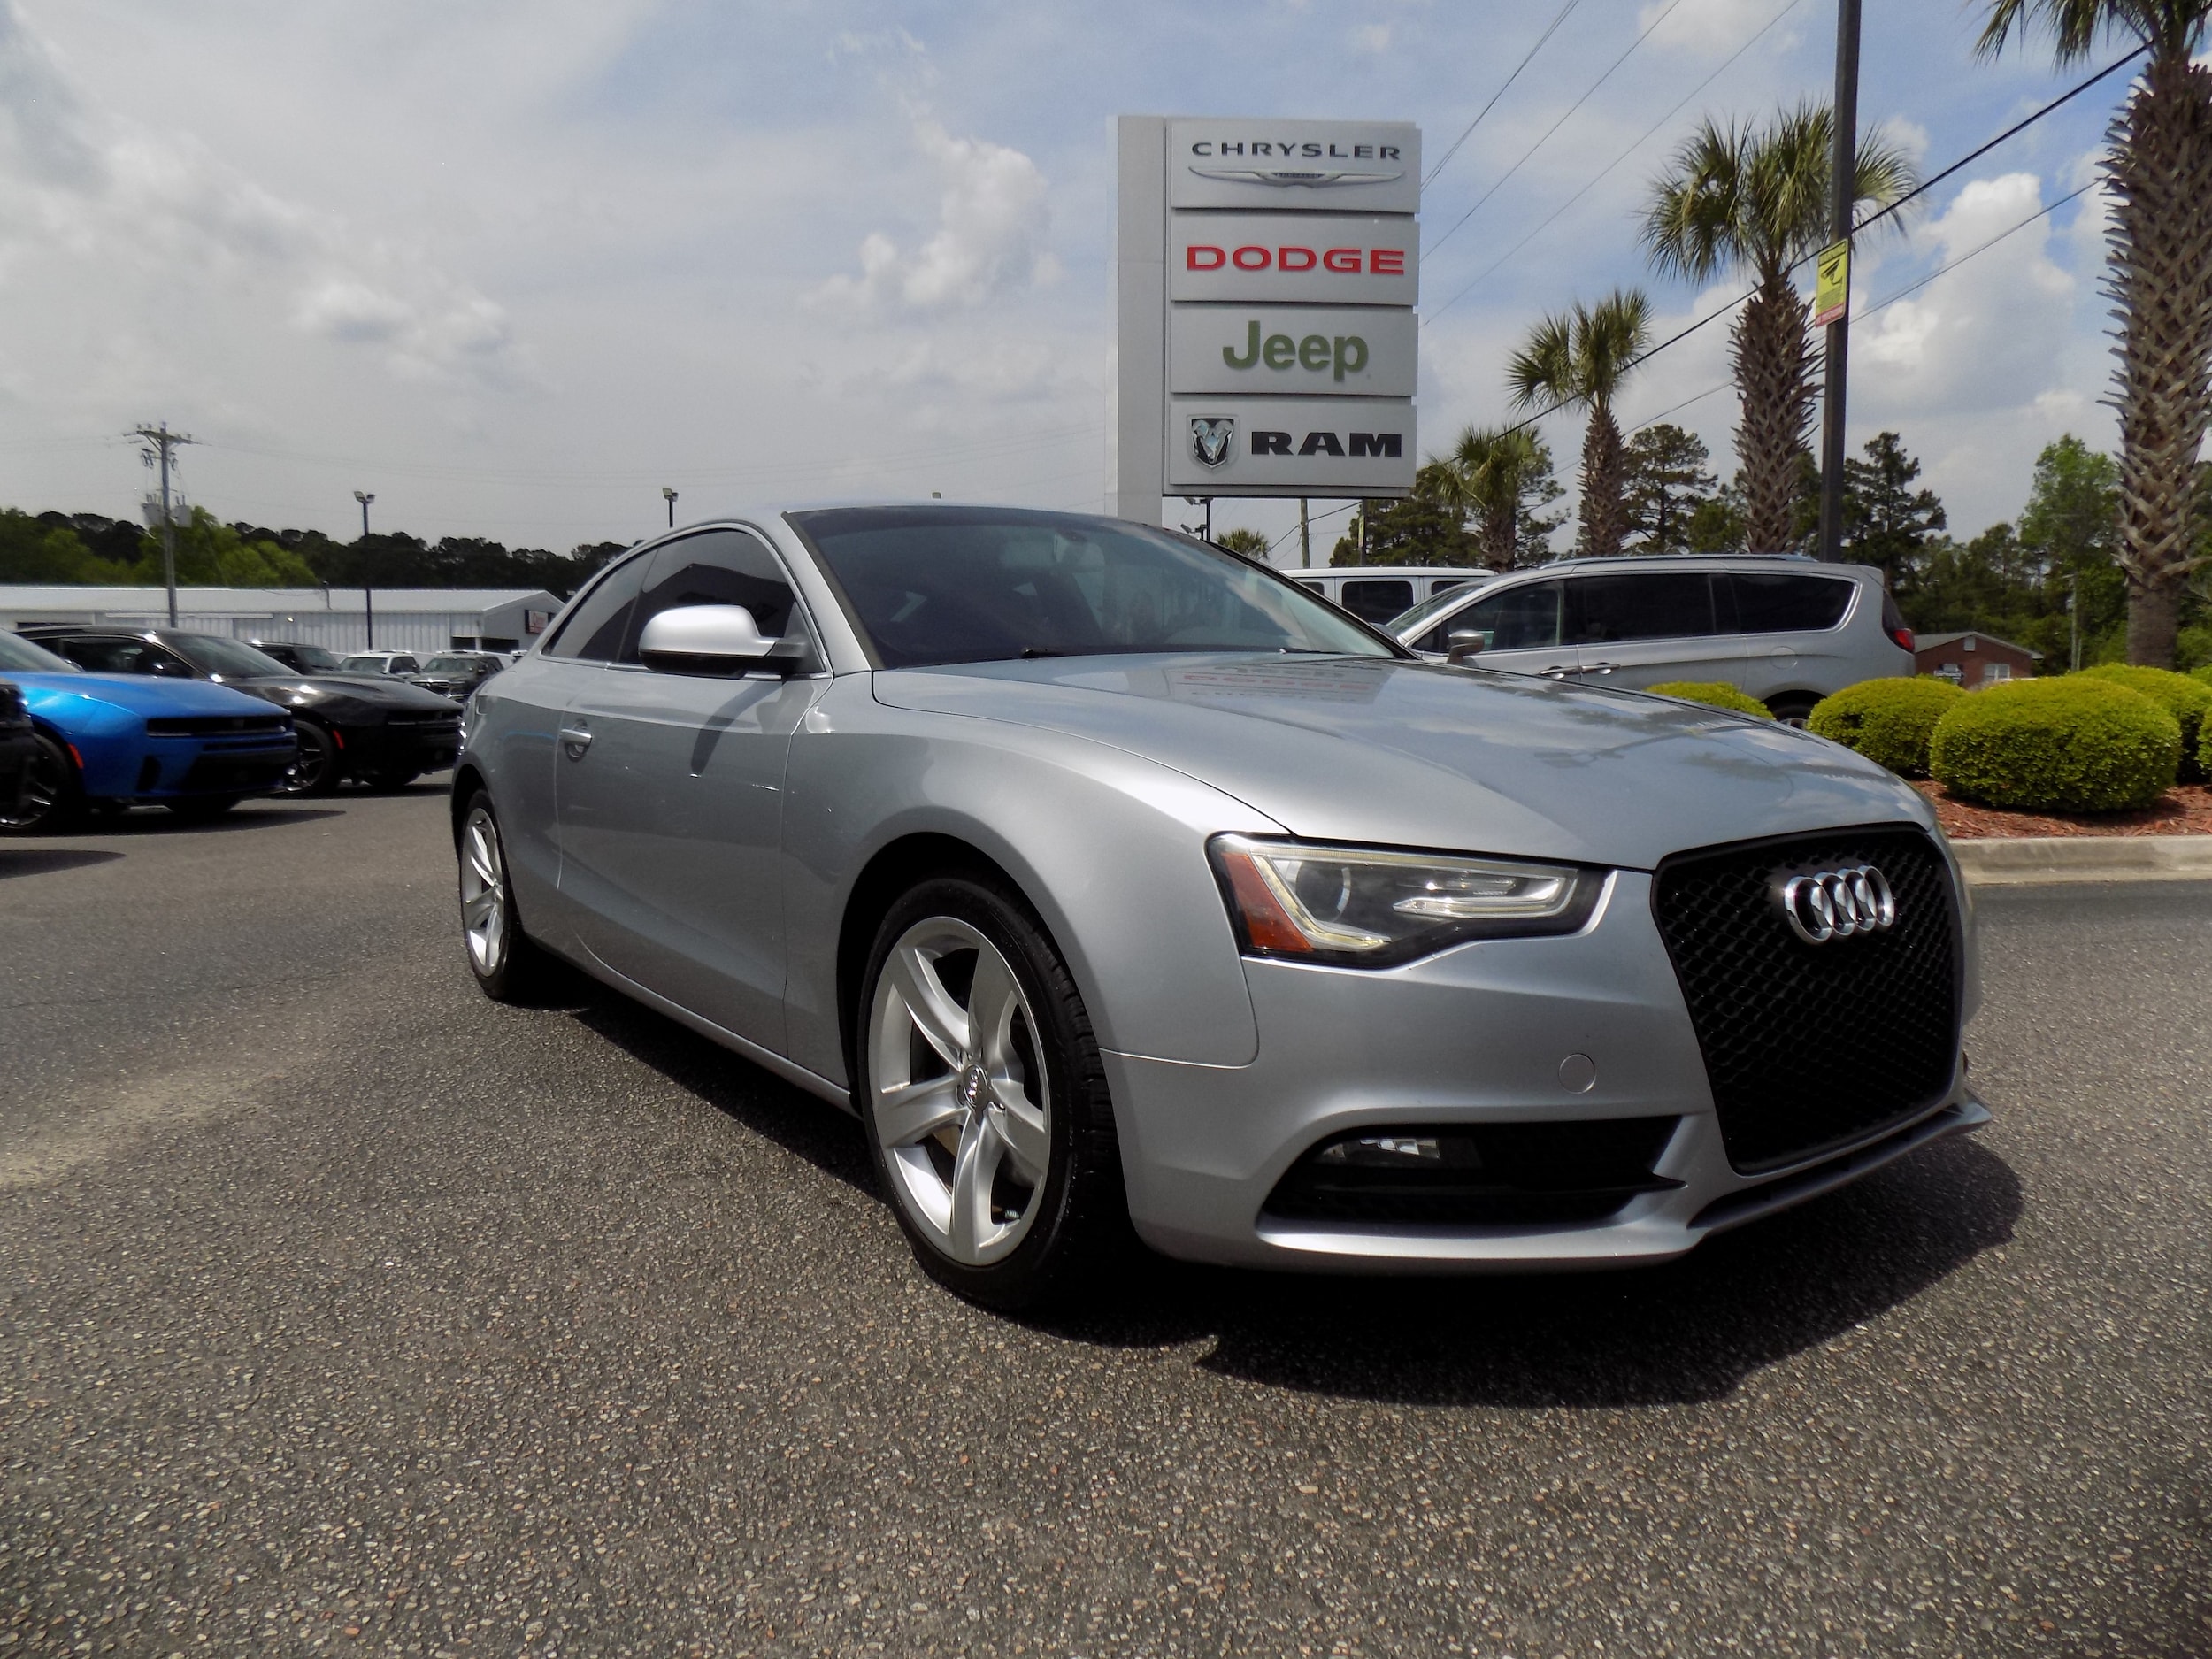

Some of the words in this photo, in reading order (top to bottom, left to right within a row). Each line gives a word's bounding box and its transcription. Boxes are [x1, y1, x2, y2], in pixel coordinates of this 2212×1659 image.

[1191, 142, 1401, 161] CHRYSLER
[1187, 245, 1405, 275] DODGE
[1222, 319, 1369, 382] Jeep
[1250, 431, 1402, 457] RAM
